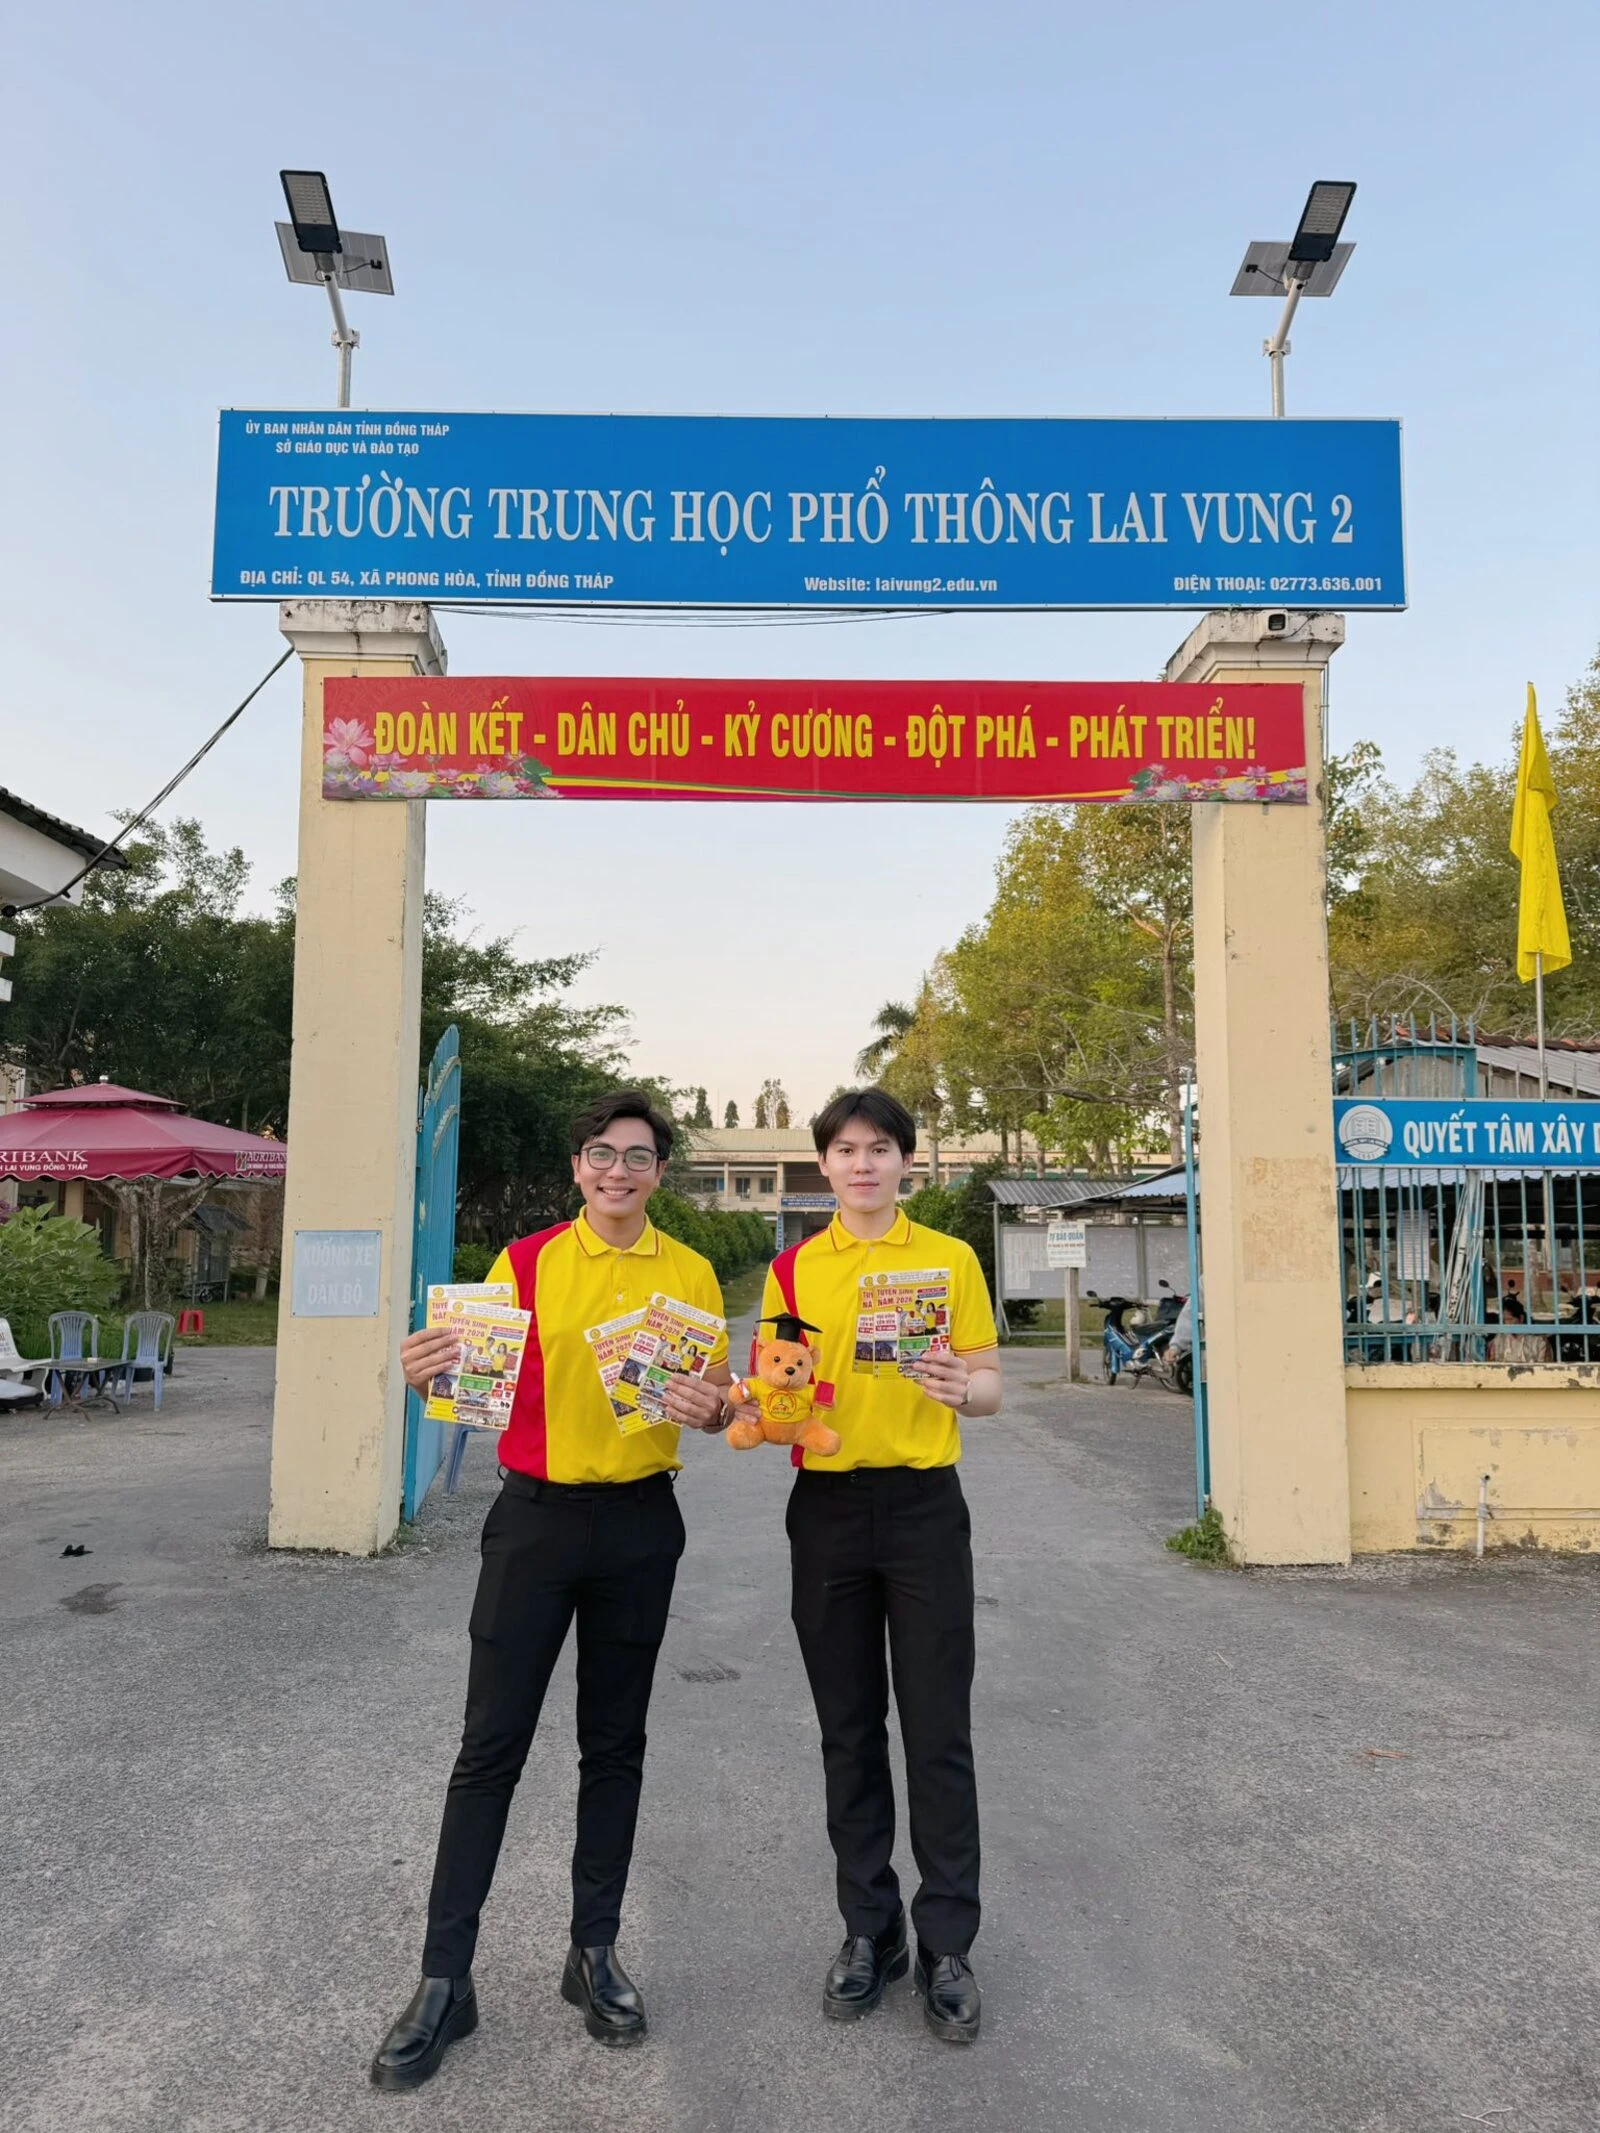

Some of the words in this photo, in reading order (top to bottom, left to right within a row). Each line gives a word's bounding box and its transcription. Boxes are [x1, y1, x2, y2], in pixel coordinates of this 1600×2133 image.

[245, 419, 260, 434] ỦY
[264, 422, 288, 434] BAN
[292, 421, 324, 435] NHÂN
[328, 421, 351, 435] DÂN
[355, 420, 381, 436] TỈNH
[385, 421, 416, 436] ĐỒNG
[420, 422, 449, 436] THÁP
[275, 438, 291, 453] SỞ
[295, 440, 322, 454] GIÁO
[326, 441, 349, 456] DỤC
[352, 440, 367, 454] VÀ
[370, 440, 394, 454] ĐÀO
[397, 442, 419, 456] TẠO
[269, 470, 474, 540] TRƯỜNG
[487, 488, 656, 543] TRUNG
[669, 490, 773, 557] HỌC
[787, 465, 890, 545] PHỔ
[903, 476, 1074, 545] THÔNG
[1087, 492, 1169, 545] LAI
[1181, 491, 1318, 545] VUNG
[1330, 494, 1354, 545] 2
[240, 570, 267, 587] ĐỊA
[271, 566, 302, 585] CHỈ:
[306, 571, 326, 586] QL
[330, 571, 354, 587] 54,
[359, 568, 382, 586] XÃ
[385, 571, 439, 586] PHONG
[444, 568, 480, 588] HÒA,
[485, 567, 522, 587] TỈNH
[526, 568, 570, 588] ĐỒNG
[573, 570, 614, 589] THÁP
[804, 576, 871, 591] Website:
[875, 577, 998, 593] laivung2.edu.vn
[1173, 574, 1211, 594] ĐIỆN
[1215, 576, 1265, 594] THOẠI:
[1269, 577, 1383, 591] 02773.636.001
[373, 701, 457, 757] ĐOÀN
[468, 695, 524, 757] KẾT
[533, 734, 546, 744] -
[557, 702, 617, 757] DÂN
[627, 699, 691, 757] CHỦ
[700, 734, 714, 745] -
[724, 700, 761, 758] KỶ
[770, 707, 873, 758] CƯƠNG
[883, 736, 896, 746] -
[905, 704, 966, 768] ĐỘT
[976, 704, 1036, 759] PHÁ
[1045, 736, 1059, 746] -
[1069, 704, 1145, 759] PHÁT
[1156, 696, 1256, 760] TRIỂN!
[1403, 1109, 1477, 1159] QUYẾT
[1484, 1113, 1535, 1154] TÂM
[1541, 1113, 1585, 1154] XÂY
[19, 1163, 41, 1171] VUNG
[43, 1161, 66, 1171] ĐỒNG
[67, 1162, 88, 1171] THÁP
[354, 1244, 375, 1267] XE
[343, 1277, 363, 1308] BỘ
